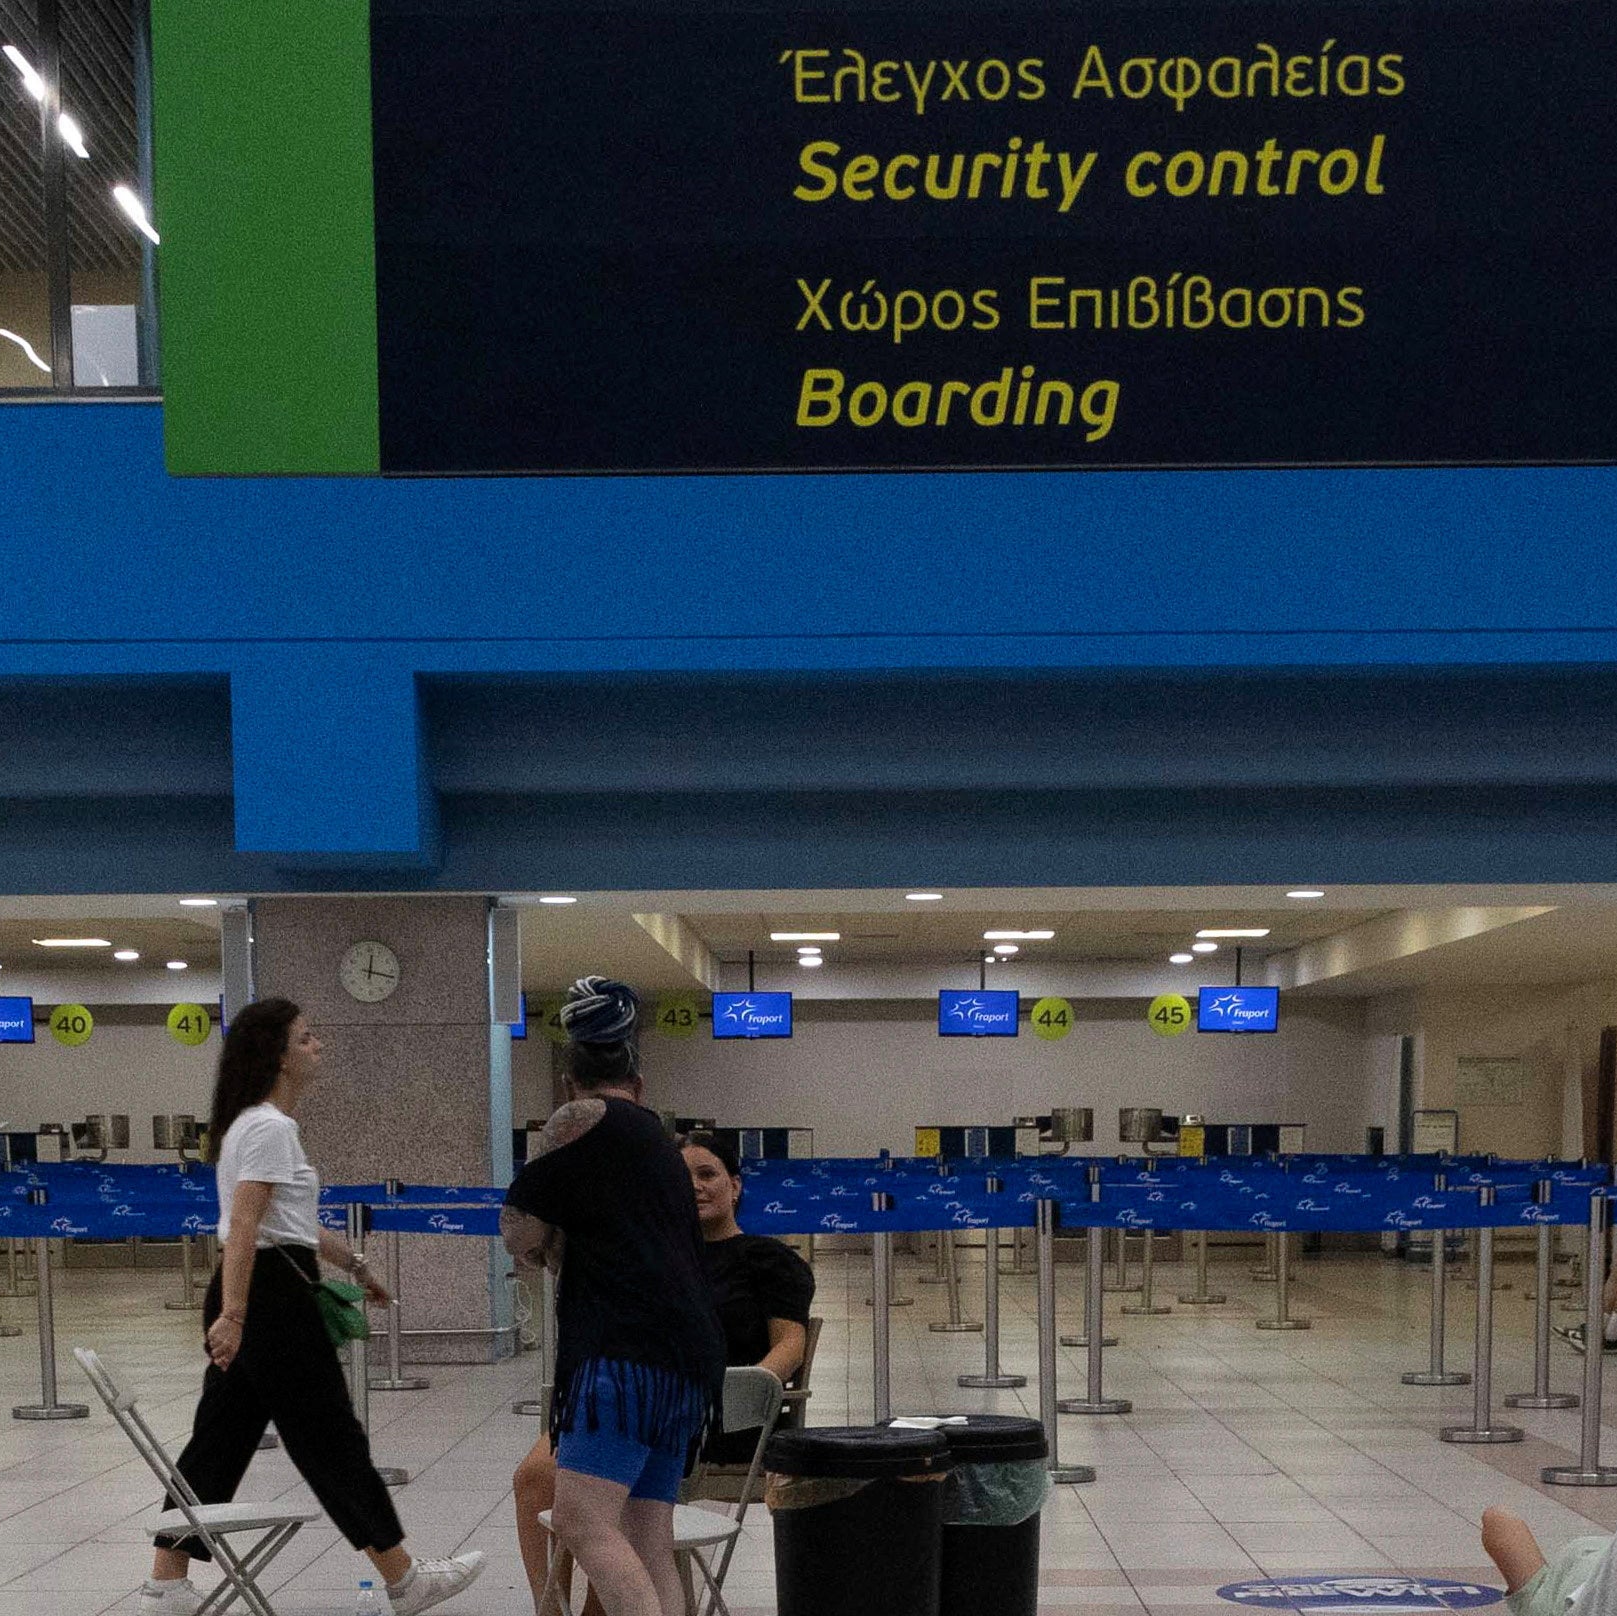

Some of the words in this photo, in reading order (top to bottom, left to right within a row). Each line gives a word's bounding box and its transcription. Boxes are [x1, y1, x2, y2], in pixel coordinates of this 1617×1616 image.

[782, 49, 1046, 114] Έλεγχος
[1073, 41, 1406, 111] Ασφαλείας
[794, 137, 1097, 212] Security
[1125, 134, 1385, 198] control
[796, 278, 1001, 343] Χώρος
[1029, 273, 1364, 330] Επιβίβασης
[796, 365, 1120, 442] Boarding
[663, 1009, 692, 1026] 43
[748, 1012, 783, 1025] Fraport
[975, 1010, 1009, 1024] Fraport
[1037, 1008, 1069, 1027] 44
[1154, 1006, 1185, 1025] 45
[1233, 1006, 1269, 1020] Fraport
[55, 1015, 86, 1034] 40
[176, 1015, 203, 1034] 41
